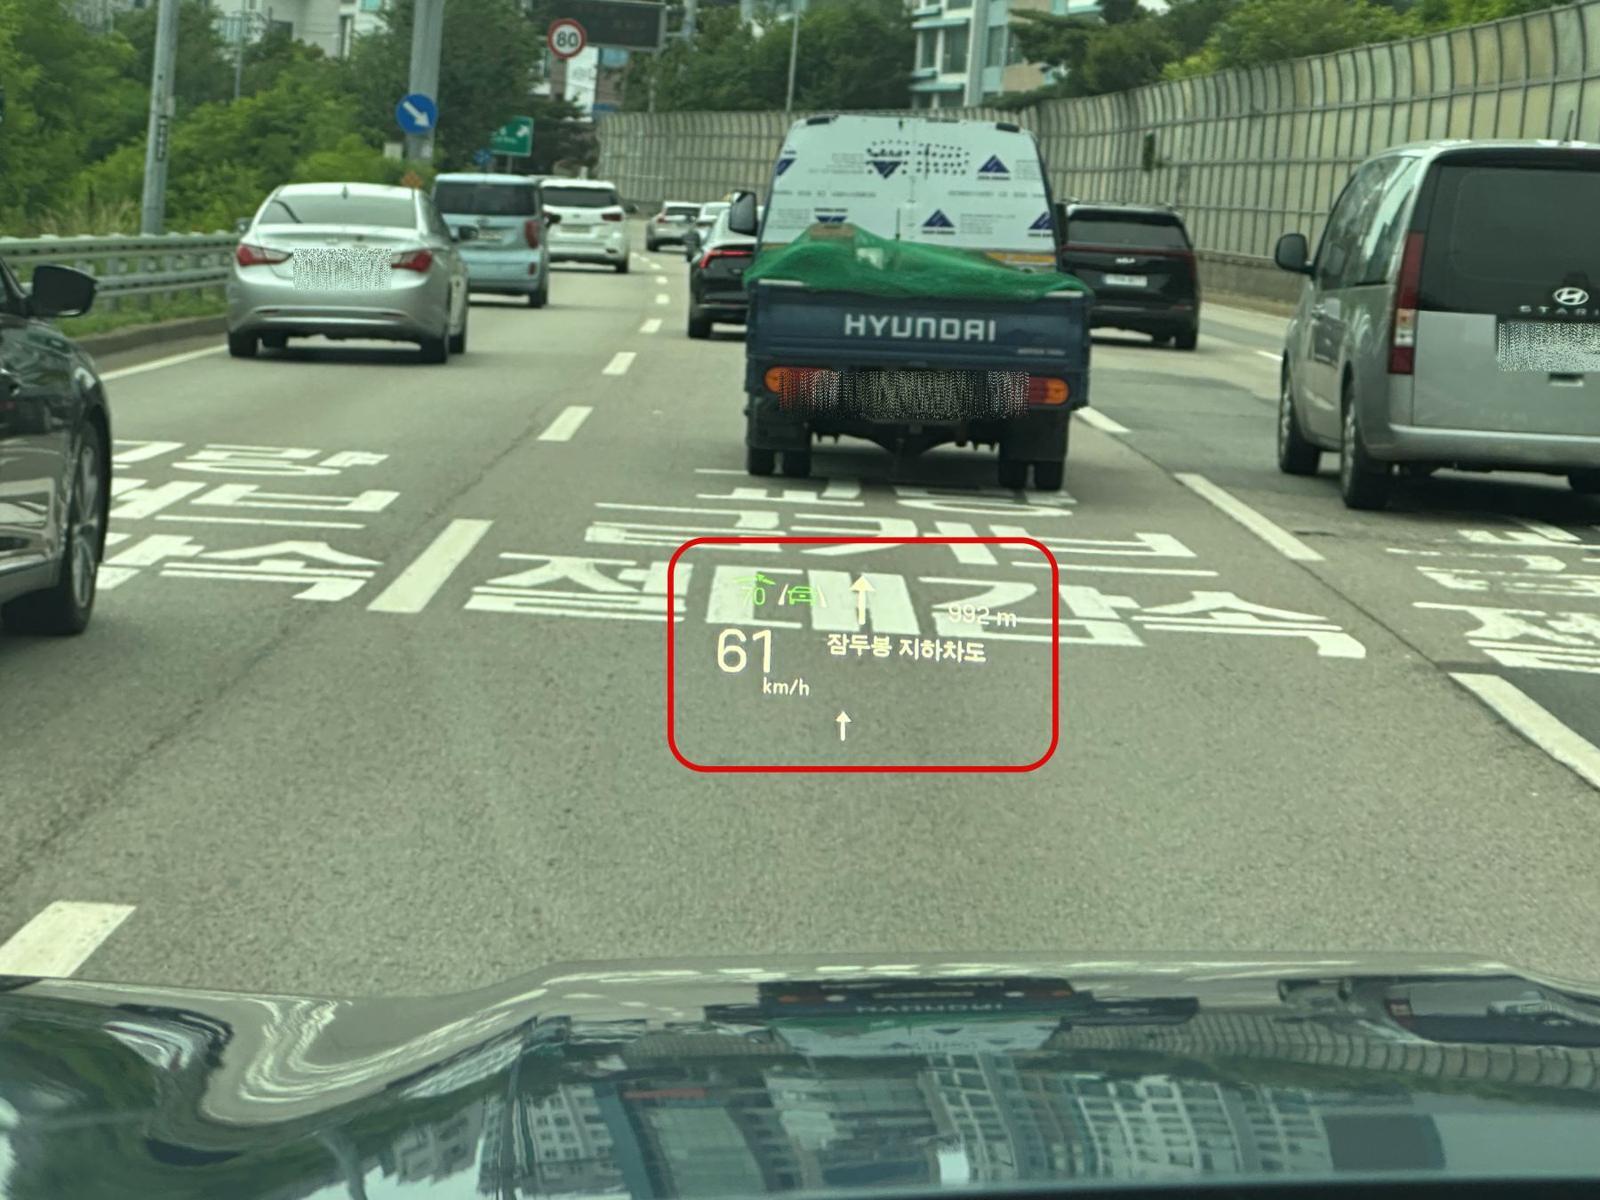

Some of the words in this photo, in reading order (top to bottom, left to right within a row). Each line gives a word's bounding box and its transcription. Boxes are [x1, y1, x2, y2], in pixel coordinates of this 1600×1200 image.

[556, 31, 579, 47] 80
[844, 313, 996, 343] HYUNDAI
[585, 502, 1220, 577] 급커브
[462, 552, 1367, 659] 절대감속
[948, 603, 990, 625] 992
[996, 610, 1017, 628] m
[717, 628, 772, 673] 61
[827, 633, 893, 658] 잠두봉
[898, 638, 987, 664] 지하차도
[762, 676, 810, 696] km/h
